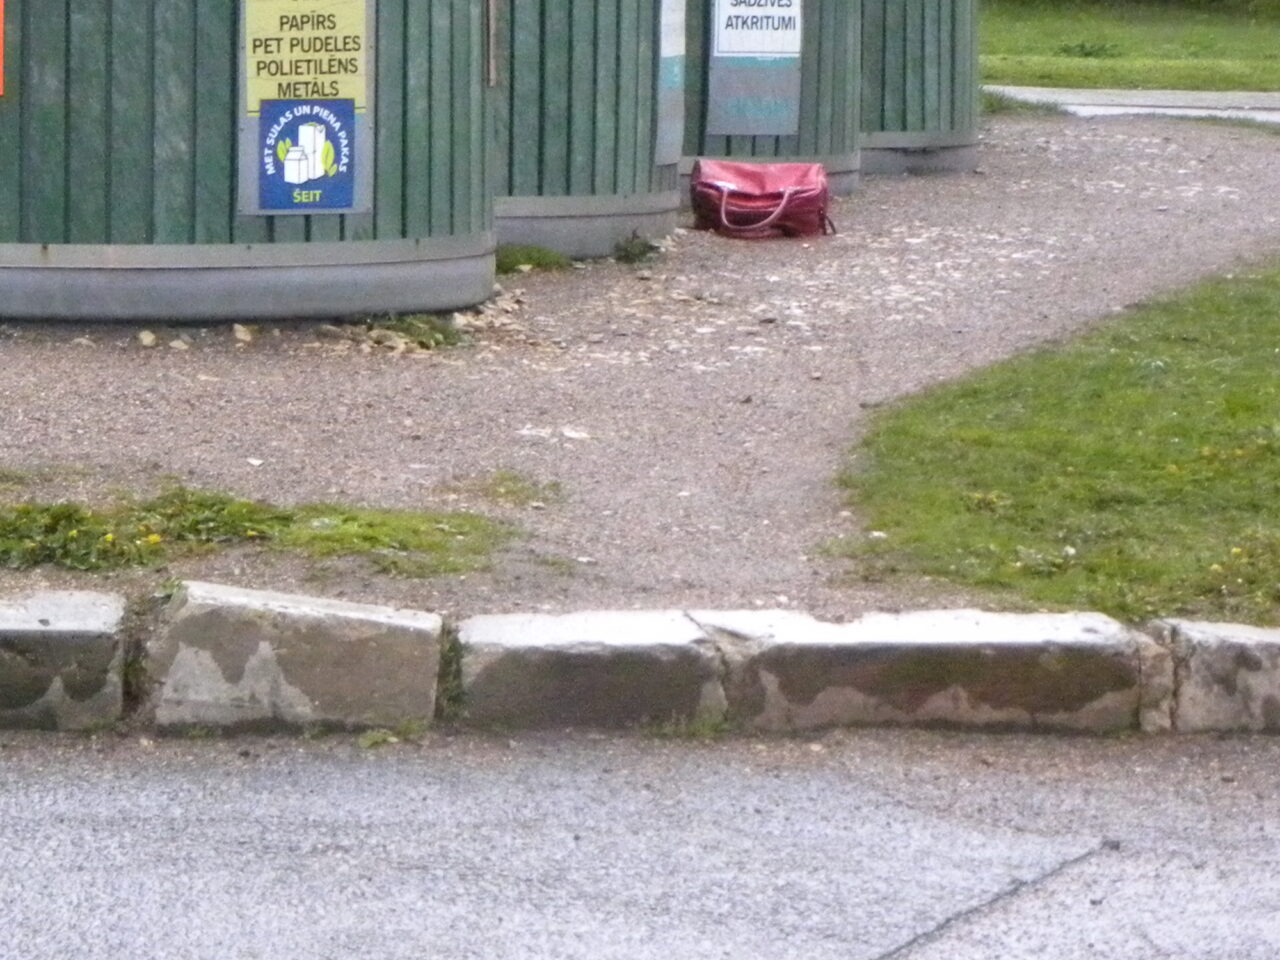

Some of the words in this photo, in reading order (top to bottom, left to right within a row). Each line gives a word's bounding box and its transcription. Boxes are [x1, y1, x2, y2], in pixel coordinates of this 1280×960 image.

[279, 10, 336, 32] PAPĪRS
[725, 15, 796, 31] ATKRITUMI
[252, 38, 283, 54] PET
[289, 35, 361, 54] PUDELES
[256, 54, 358, 77] POLIETILĒNS
[277, 76, 339, 99] METĀLS
[293, 105, 311, 117] UN
[312, 105, 341, 132] PIENA
[266, 110, 293, 146] SULAS
[264, 148, 276, 175] MET
[337, 130, 350, 173] PAKAS
[292, 188, 322, 204] ŠEIT
